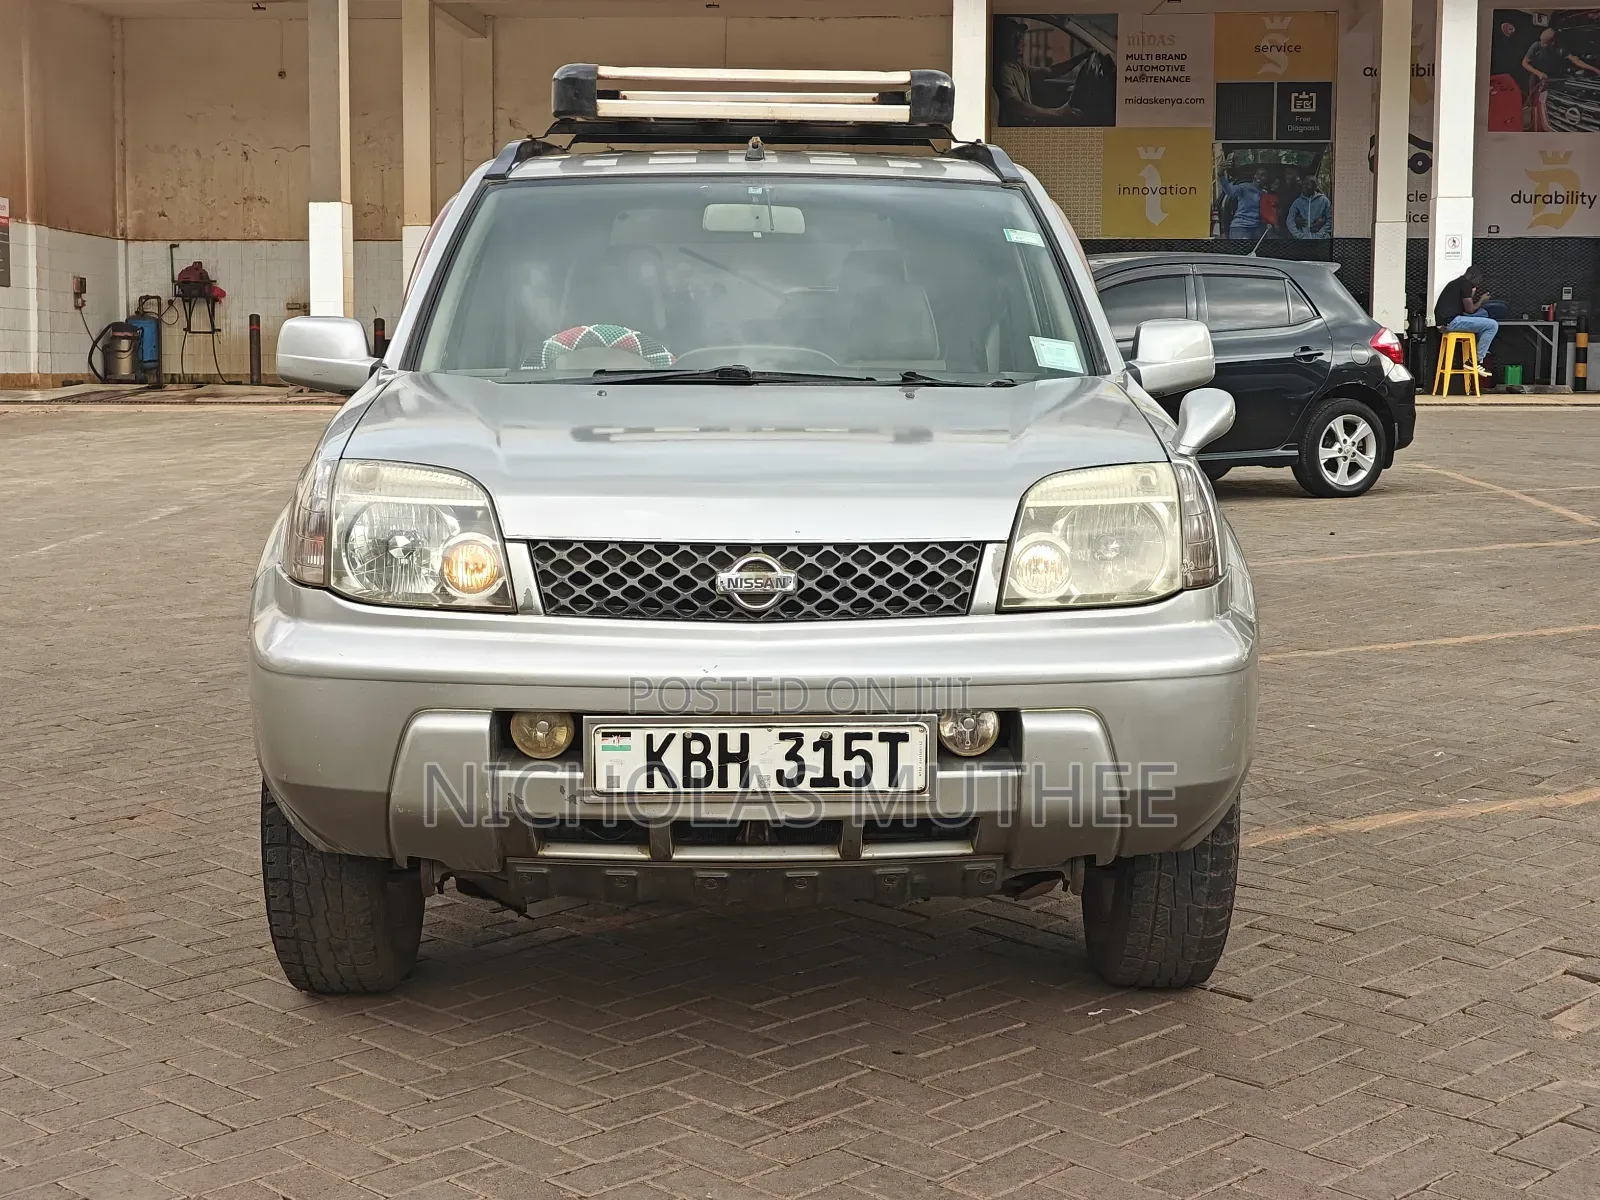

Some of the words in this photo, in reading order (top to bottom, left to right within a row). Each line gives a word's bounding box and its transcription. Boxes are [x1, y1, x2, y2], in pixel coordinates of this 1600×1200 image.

[1254, 42, 1302, 53] service
[1125, 53, 1153, 61] MULTI
[1155, 53, 1187, 61] BRAND
[1125, 64, 1186, 72] AUTOMOTIVE
[1124, 96, 1205, 106] midaskenya.com
[1287, 124, 1320, 132] Diagnosis
[1118, 184, 1197, 195] innovation
[1510, 190, 1598, 209] durability
[1406, 211, 1429, 223] ice
[727, 577, 786, 589] NISSAN
[646, 732, 750, 789] KBH
[775, 731, 910, 789] 315T
